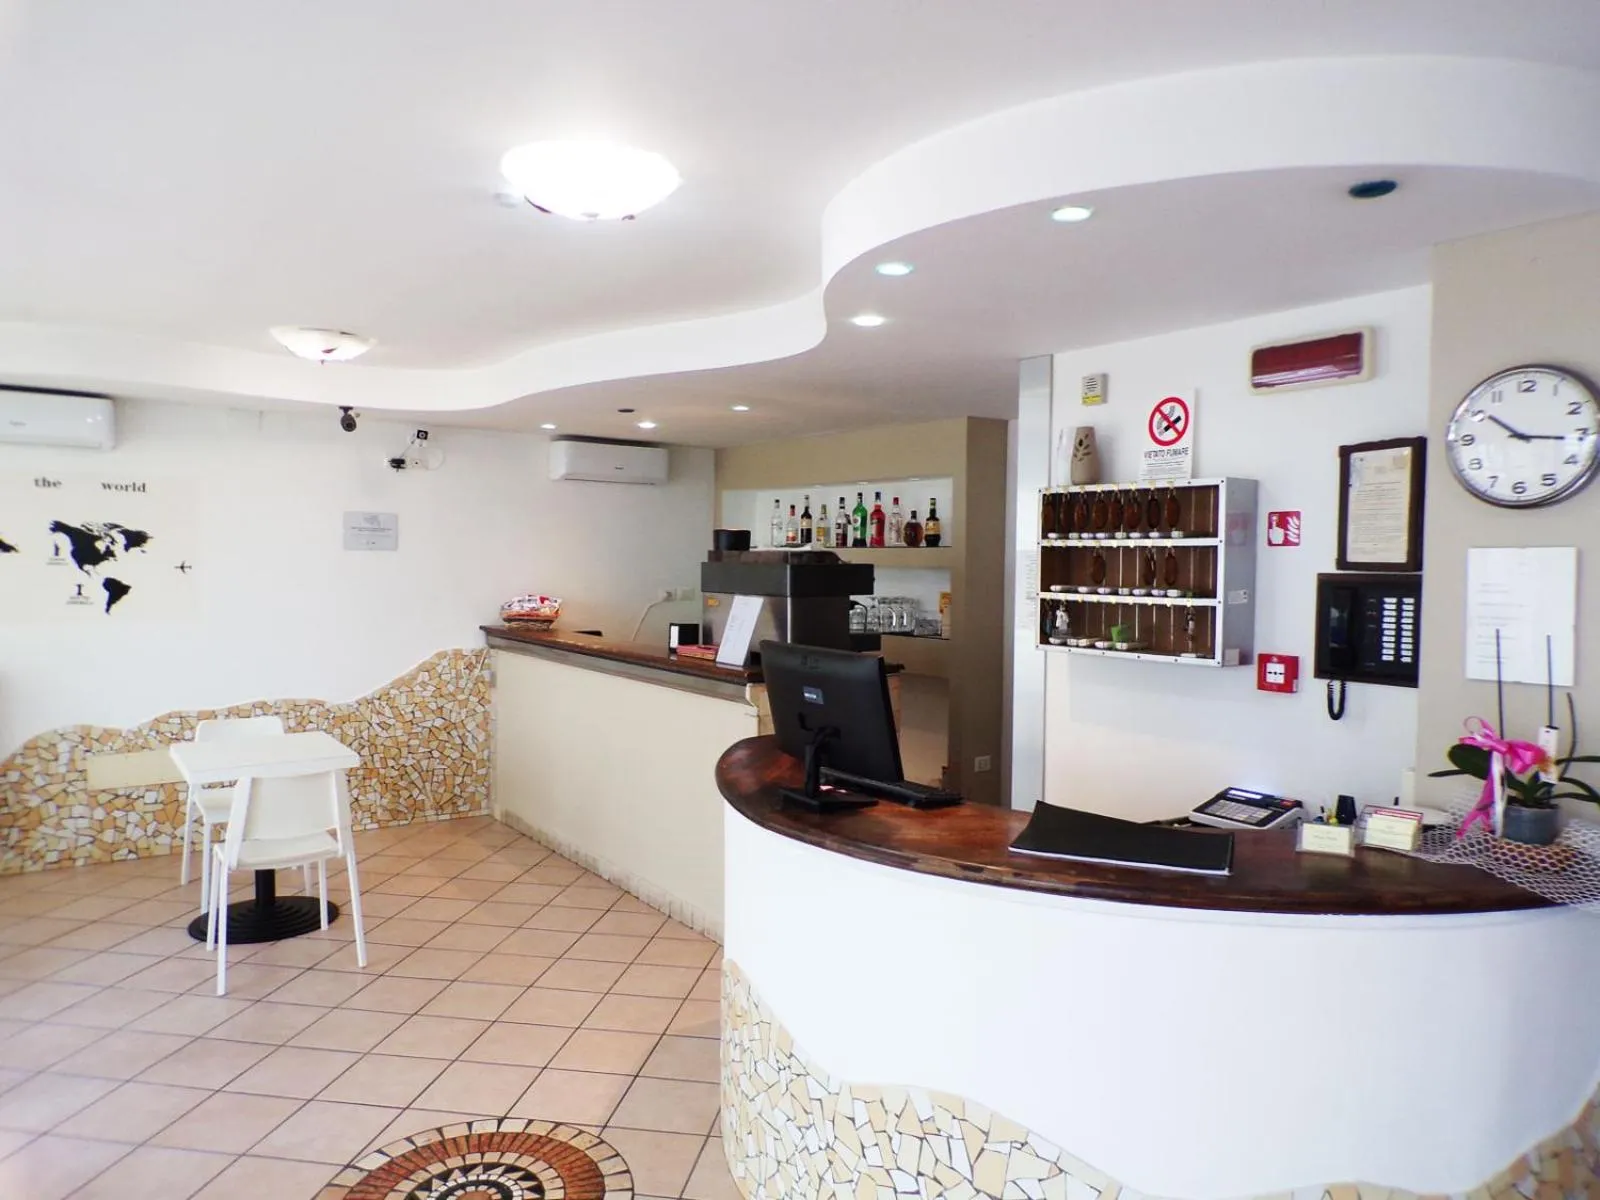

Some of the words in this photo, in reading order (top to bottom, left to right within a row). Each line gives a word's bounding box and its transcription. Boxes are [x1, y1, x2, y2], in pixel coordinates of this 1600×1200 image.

[1517, 380, 1537, 393] 12
[1491, 390, 1504, 403] 11
[1566, 402, 1583, 416] 2
[1460, 434, 1475, 446] 9
[1144, 449, 1165, 459] VIETATO
[1166, 447, 1189, 457] FUMARE
[1468, 458, 1483, 471] 8
[1563, 454, 1579, 466] 4
[34, 476, 62, 489] the
[101, 481, 147, 493] world
[1487, 476, 1500, 489] 7
[1541, 473, 1557, 487] 5
[1512, 482, 1527, 494] 6
